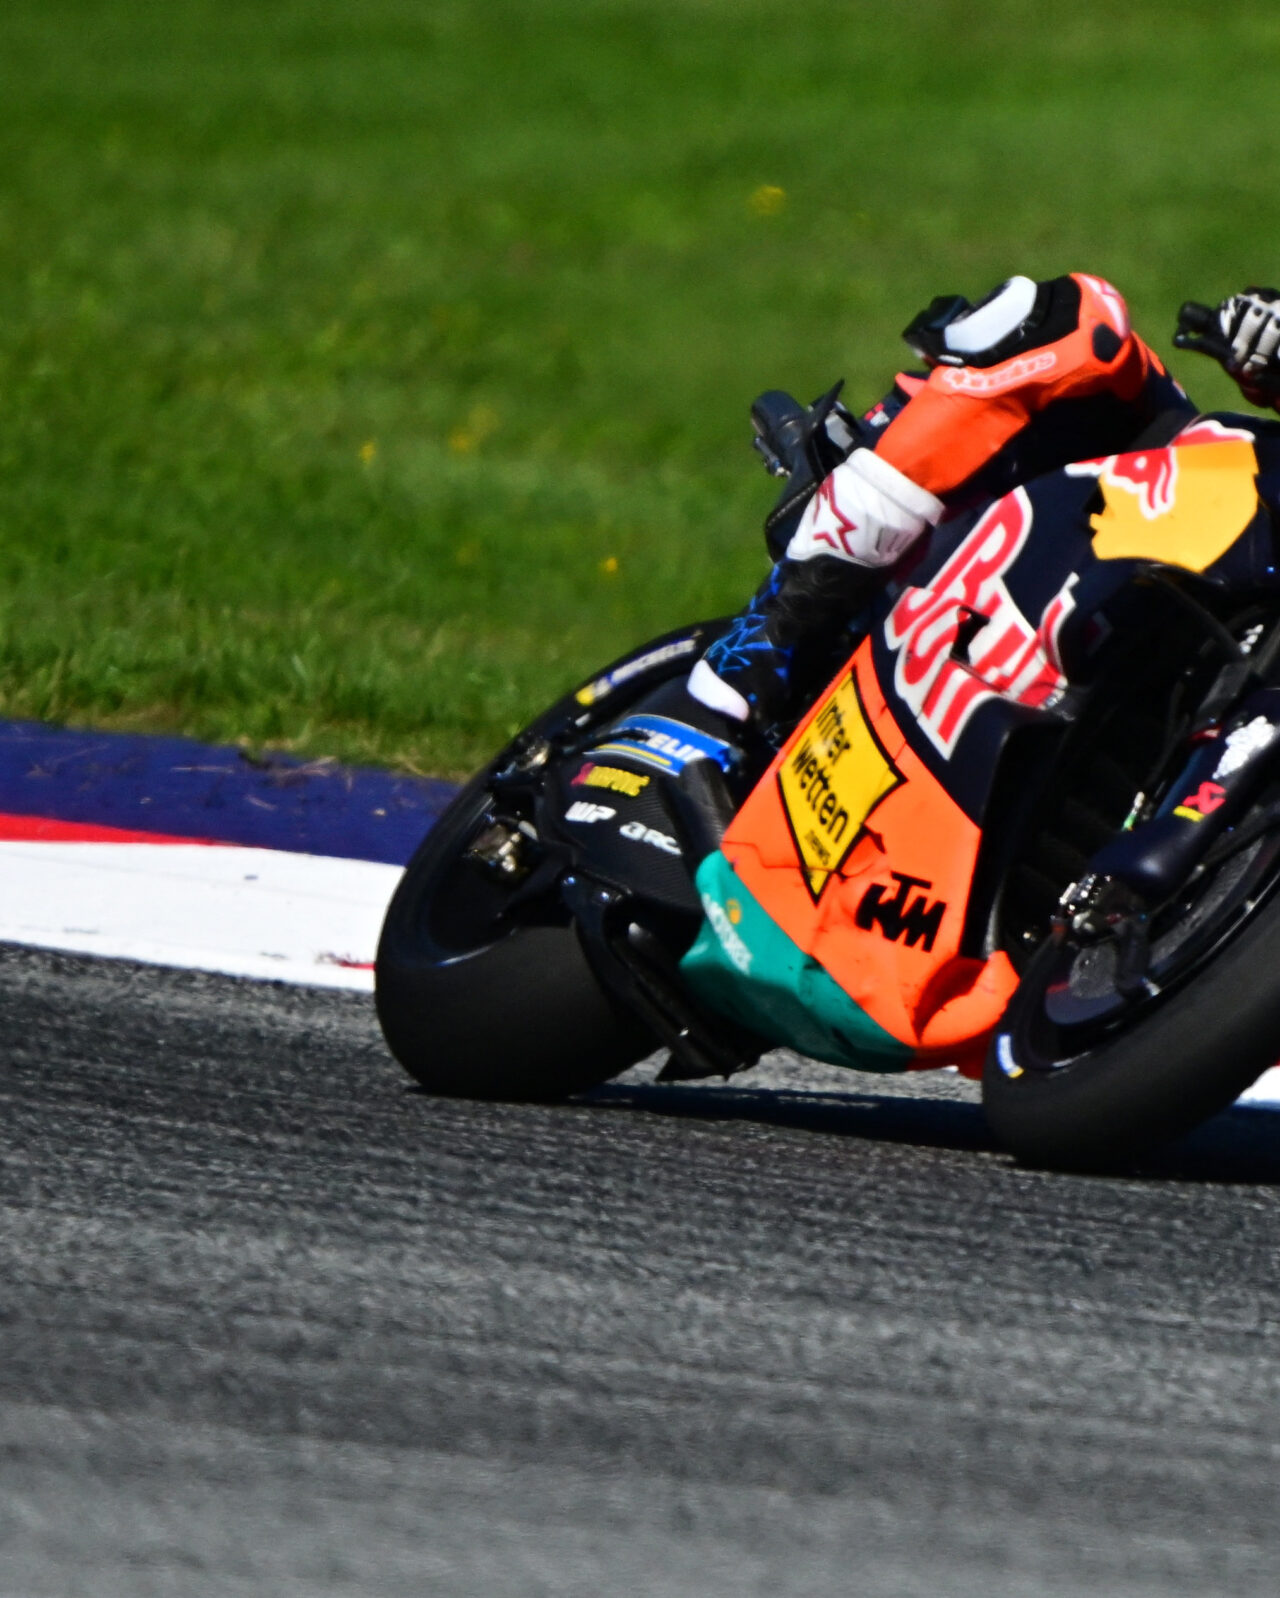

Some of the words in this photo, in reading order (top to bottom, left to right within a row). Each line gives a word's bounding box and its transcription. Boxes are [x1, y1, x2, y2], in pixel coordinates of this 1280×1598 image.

[815, 696, 851, 766] inter
[791, 736, 849, 844] wetten
[854, 869, 947, 953] KTM
